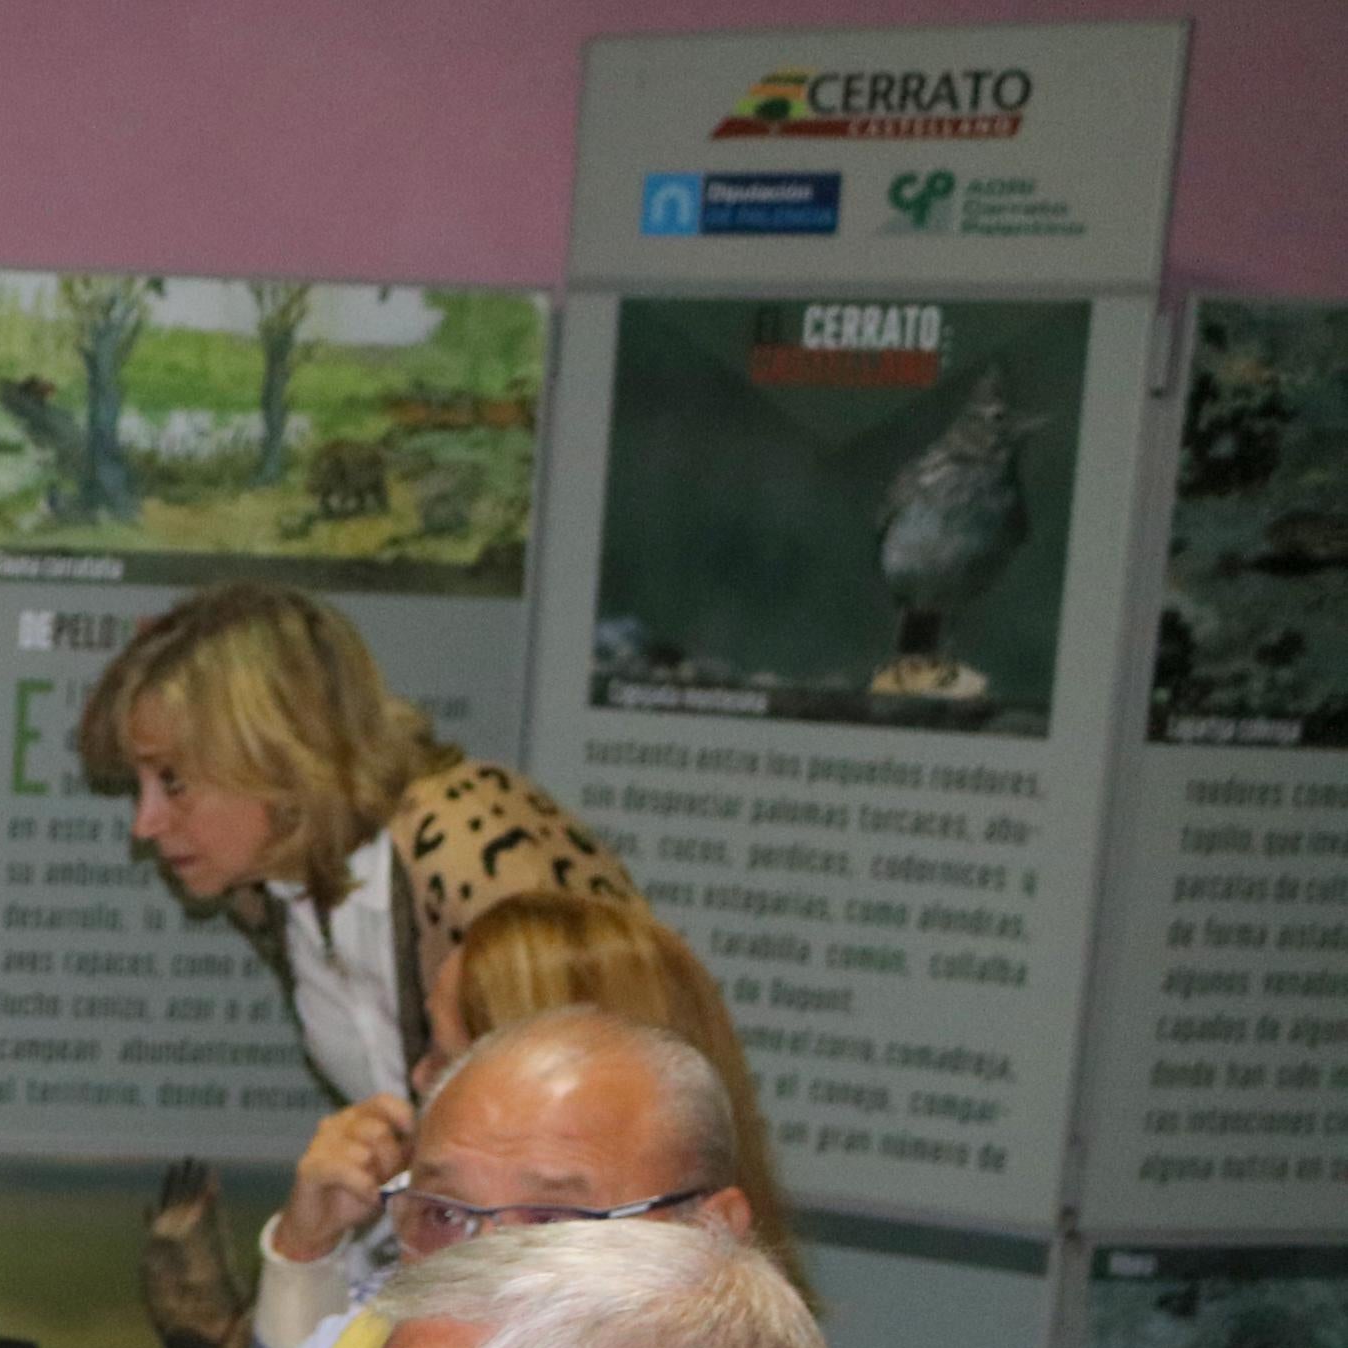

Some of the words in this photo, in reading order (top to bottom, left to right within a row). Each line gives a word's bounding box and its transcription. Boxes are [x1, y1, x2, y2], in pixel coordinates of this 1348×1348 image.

[808, 69, 1032, 113] CERRATO
[848, 116, 1011, 137] CASTELLANO
[707, 181, 815, 205] Diputación
[801, 304, 942, 352] CERRATO
[52, 611, 118, 652] PELO
[697, 746, 760, 775] entre
[766, 747, 802, 779] los
[808, 752, 923, 791] pequeños
[1185, 774, 1284, 810] roedores
[7, 817, 37, 840] en
[48, 818, 104, 842] este
[580, 782, 616, 809] sin
[622, 783, 743, 818] despreciar
[750, 796, 849, 834] palomas
[859, 804, 974, 845] torcaces,
[1263, 830, 1305, 859] que
[6, 861, 34, 885] su
[748, 841, 854, 881] perdices,
[869, 852, 1008, 893] codornices
[1172, 874, 1270, 905] parcelas
[1274, 872, 1301, 905] de
[1306, 875, 1348, 906] cult
[845, 898, 909, 931] como
[1166, 917, 1197, 950] de
[1203, 914, 1269, 949] forma
[1, 949, 55, 974] aves
[62, 949, 163, 979] rapaces,
[170, 952, 236, 978] como
[733, 974, 761, 1003] de
[1255, 1013, 1281, 1043] de
[118, 1036, 305, 1068] abundantement
[1150, 1059, 1217, 1088] donde
[1225, 1060, 1266, 1090] han
[25, 1079, 147, 1107] territorio,
[156, 1078, 231, 1110] donde
[816, 1123, 872, 1154] gran
[878, 1129, 971, 1168] número
[977, 1141, 1008, 1175] de
